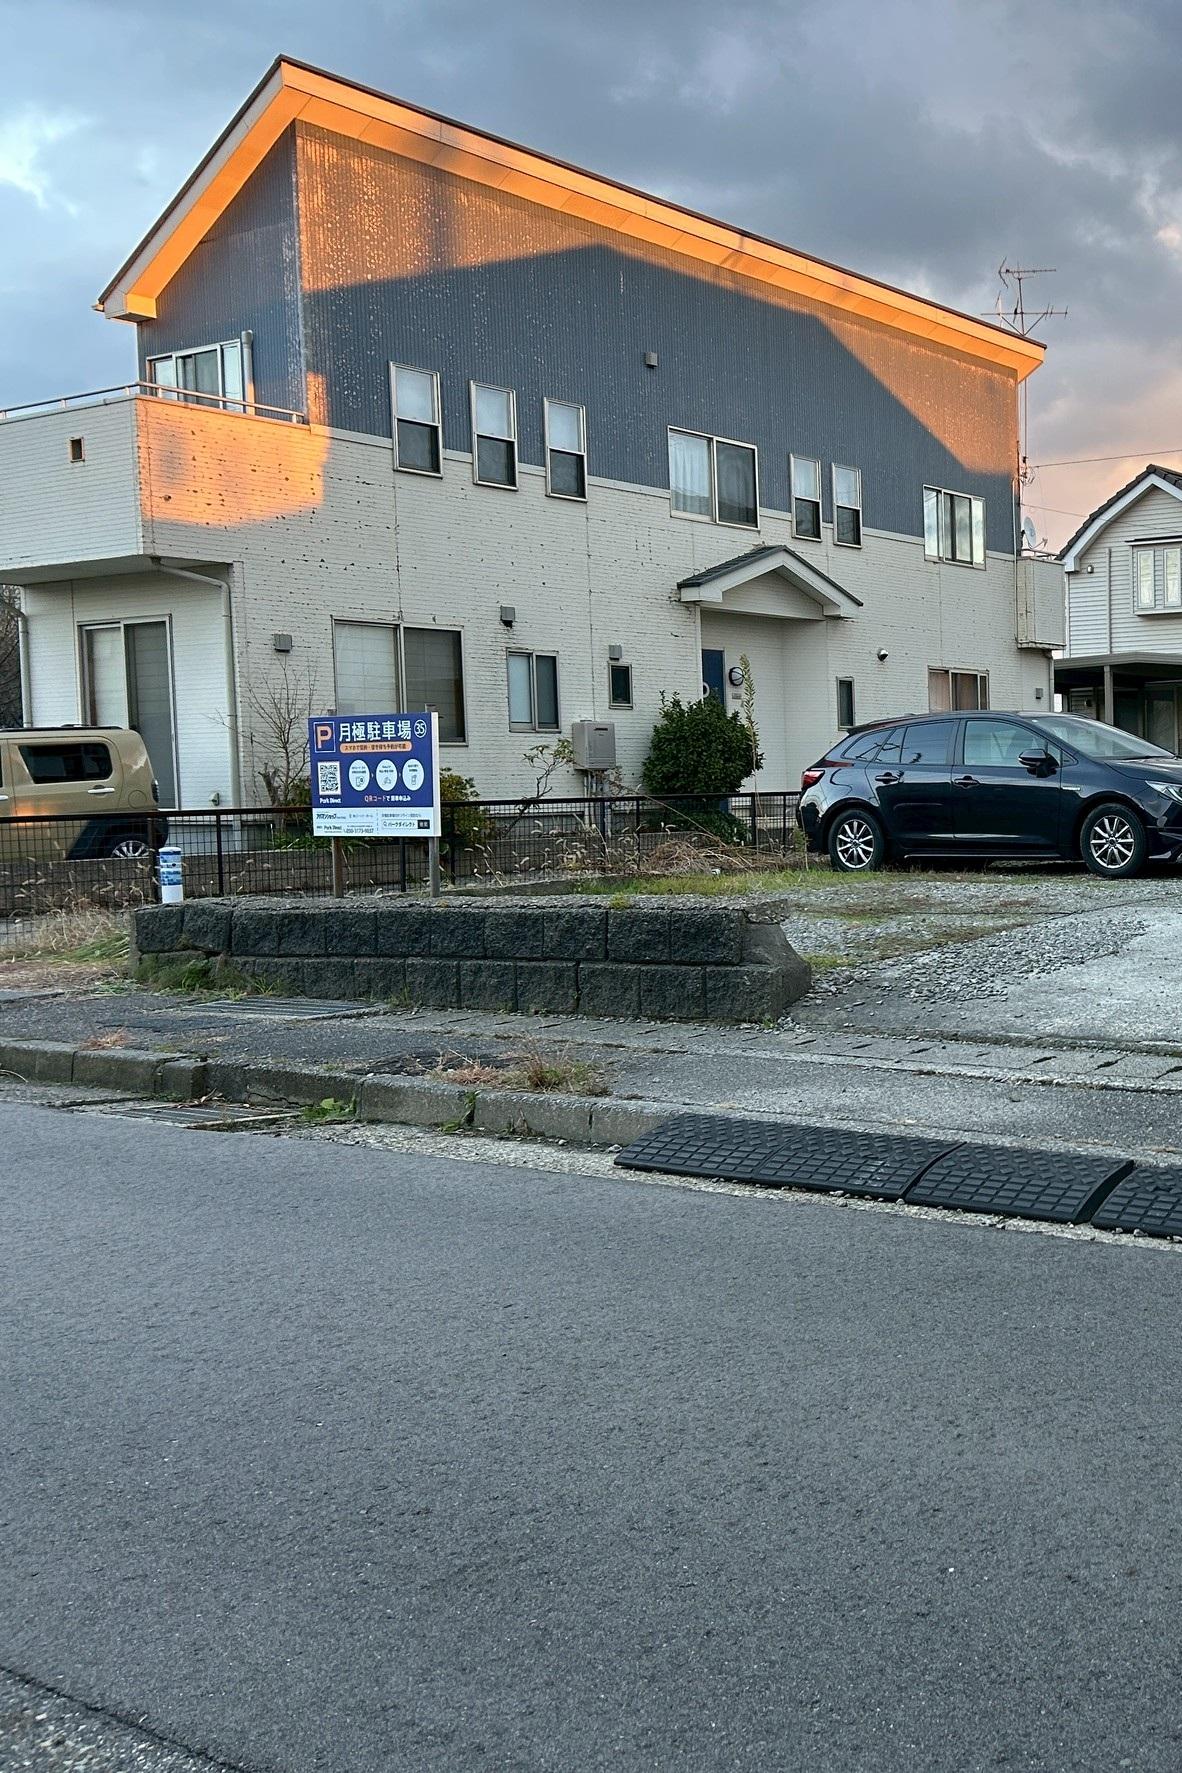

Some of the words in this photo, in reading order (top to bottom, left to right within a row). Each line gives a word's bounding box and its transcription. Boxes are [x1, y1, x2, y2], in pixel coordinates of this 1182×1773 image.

[316, 725, 332, 749] P
[339, 720, 412, 741] 月極駐車場
